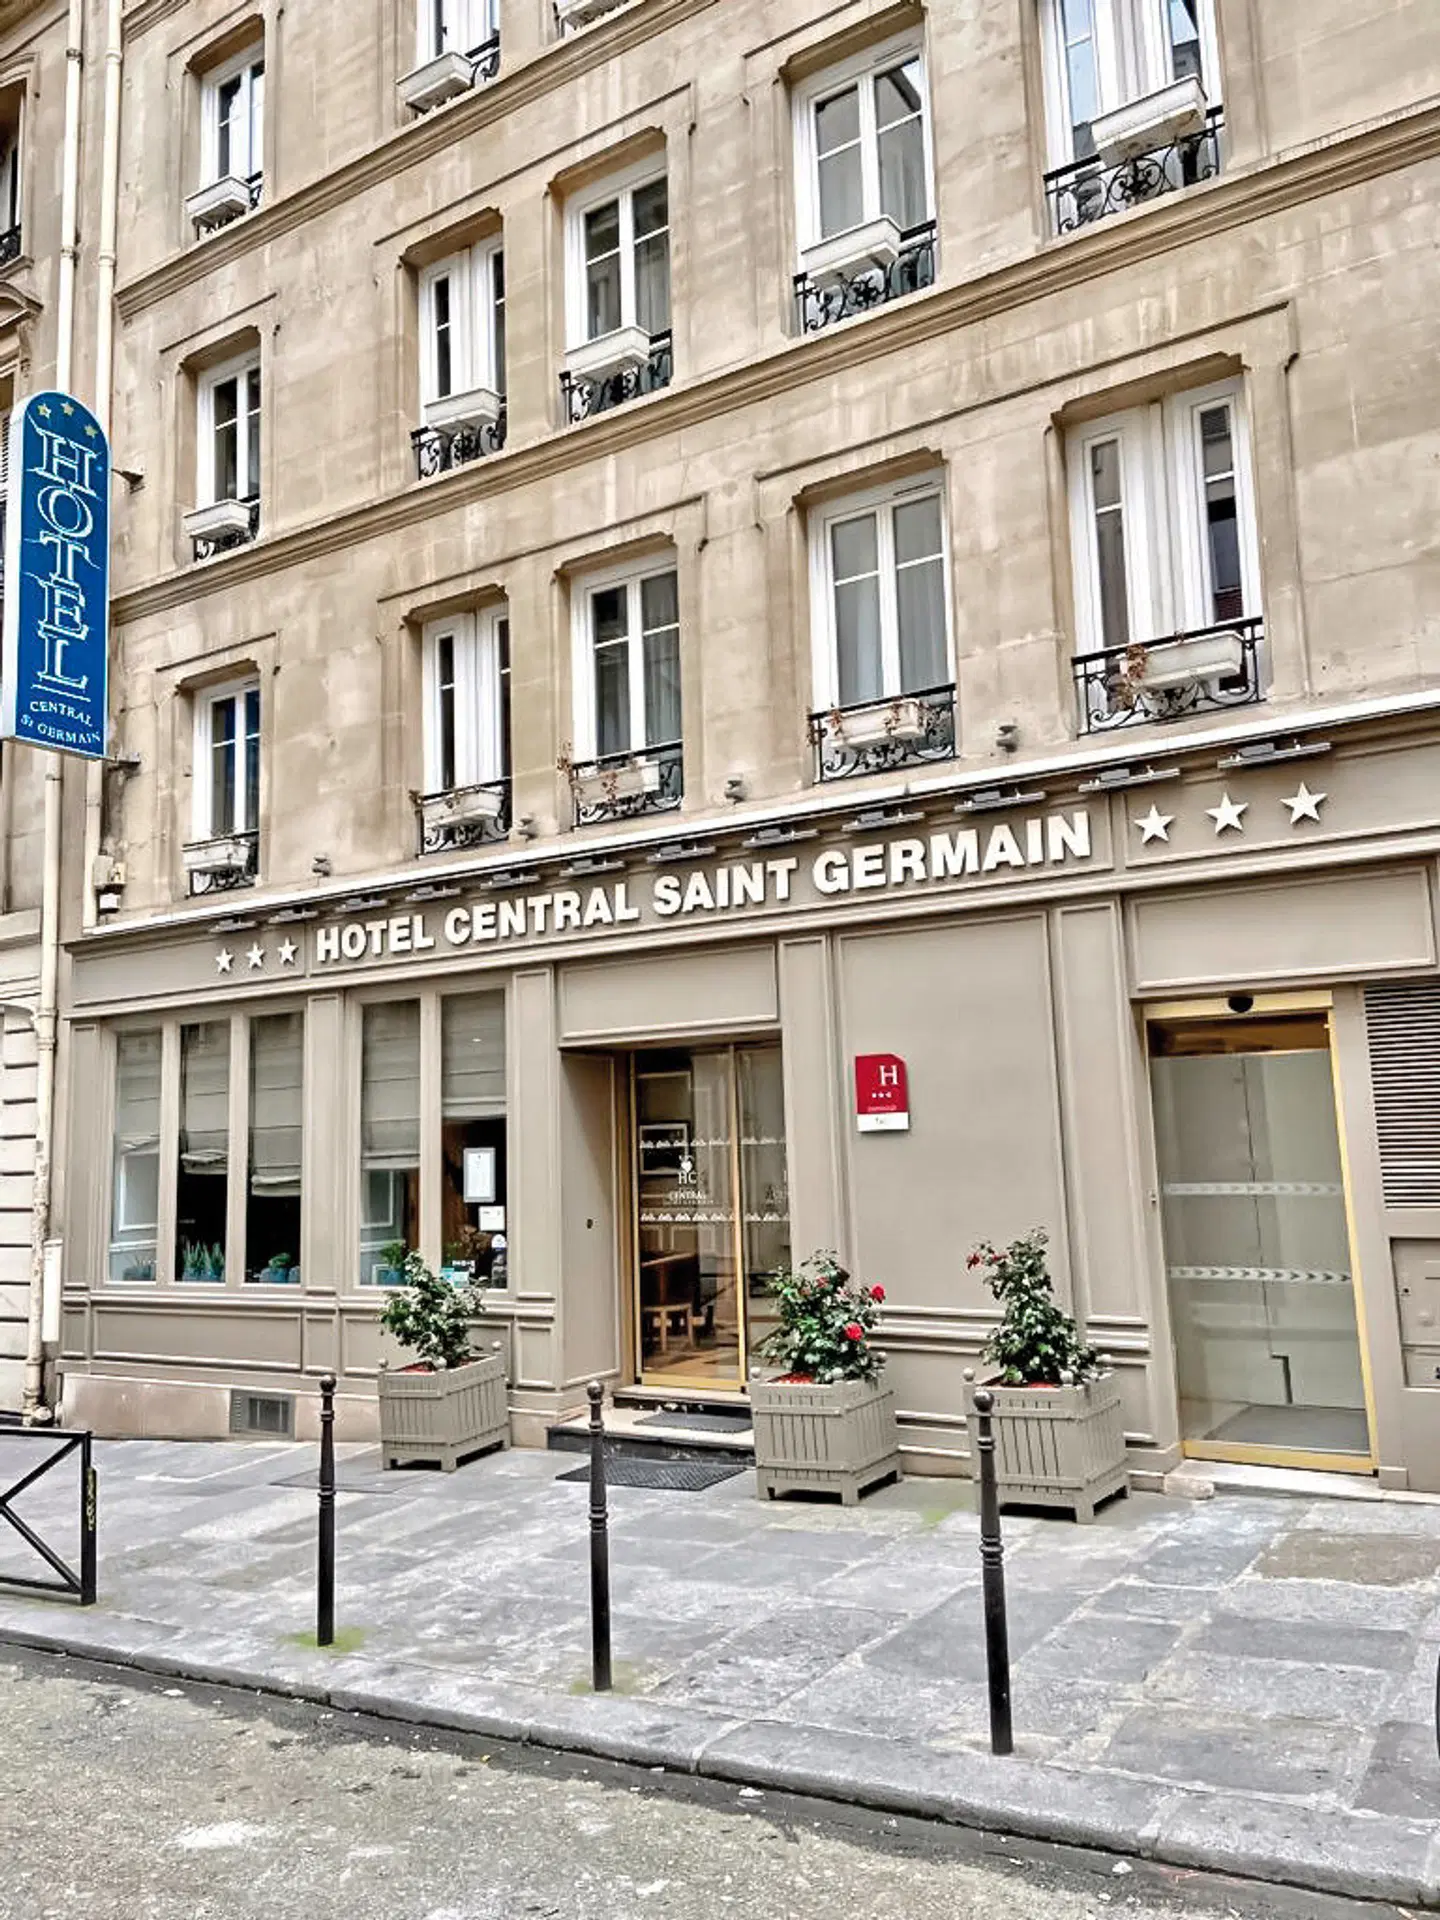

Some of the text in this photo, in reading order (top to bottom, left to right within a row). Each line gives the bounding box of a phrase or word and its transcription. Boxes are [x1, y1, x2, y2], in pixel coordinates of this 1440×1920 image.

[26, 420, 100, 690] HOTEL
[30, 701, 93, 727] CENTRAL
[37, 722, 101, 744] GERMAIN
[315, 809, 1091, 963] HOTEL CENTRAL SAINT GERMAIN
[879, 1064, 899, 1086] H
